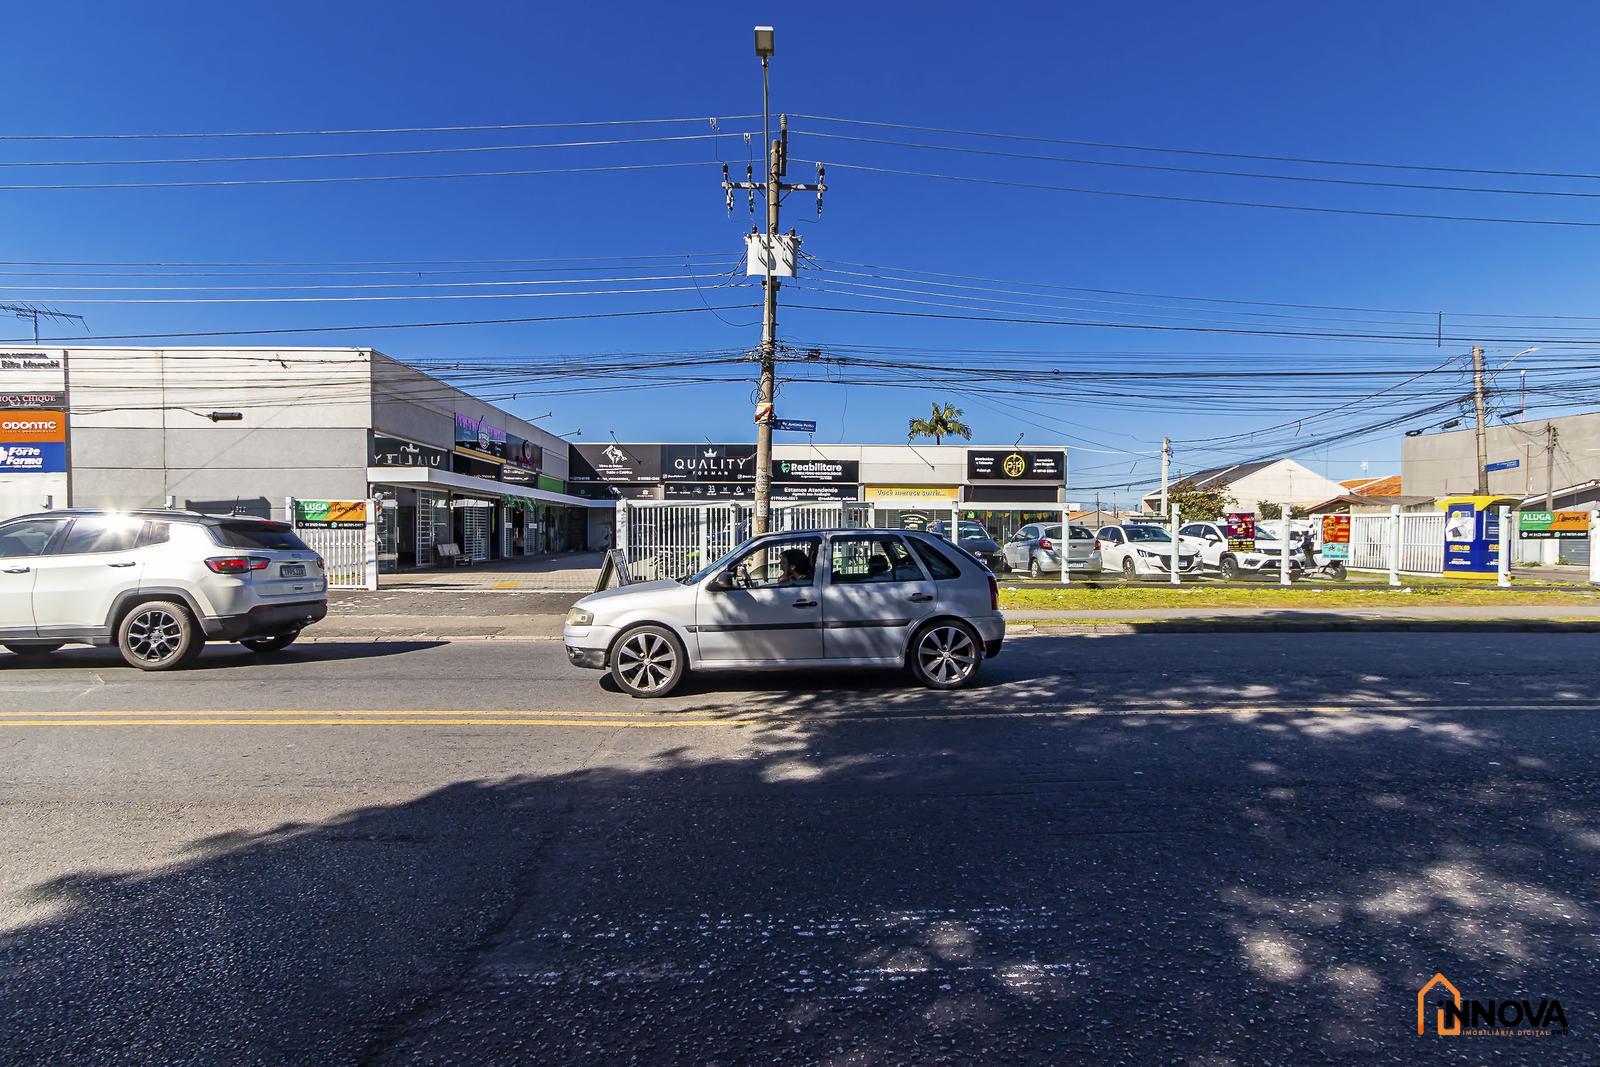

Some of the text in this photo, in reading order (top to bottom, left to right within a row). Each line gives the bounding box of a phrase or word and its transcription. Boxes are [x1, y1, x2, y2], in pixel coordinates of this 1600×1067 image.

[22, 394, 57, 403] CHIQUE
[9, 446, 41, 456] Forte
[6, 457, 43, 465] Farma
[674, 458, 746, 470] QUALITY
[791, 462, 843, 472] Reabilitare
[1522, 513, 1552, 521] ALUGA
